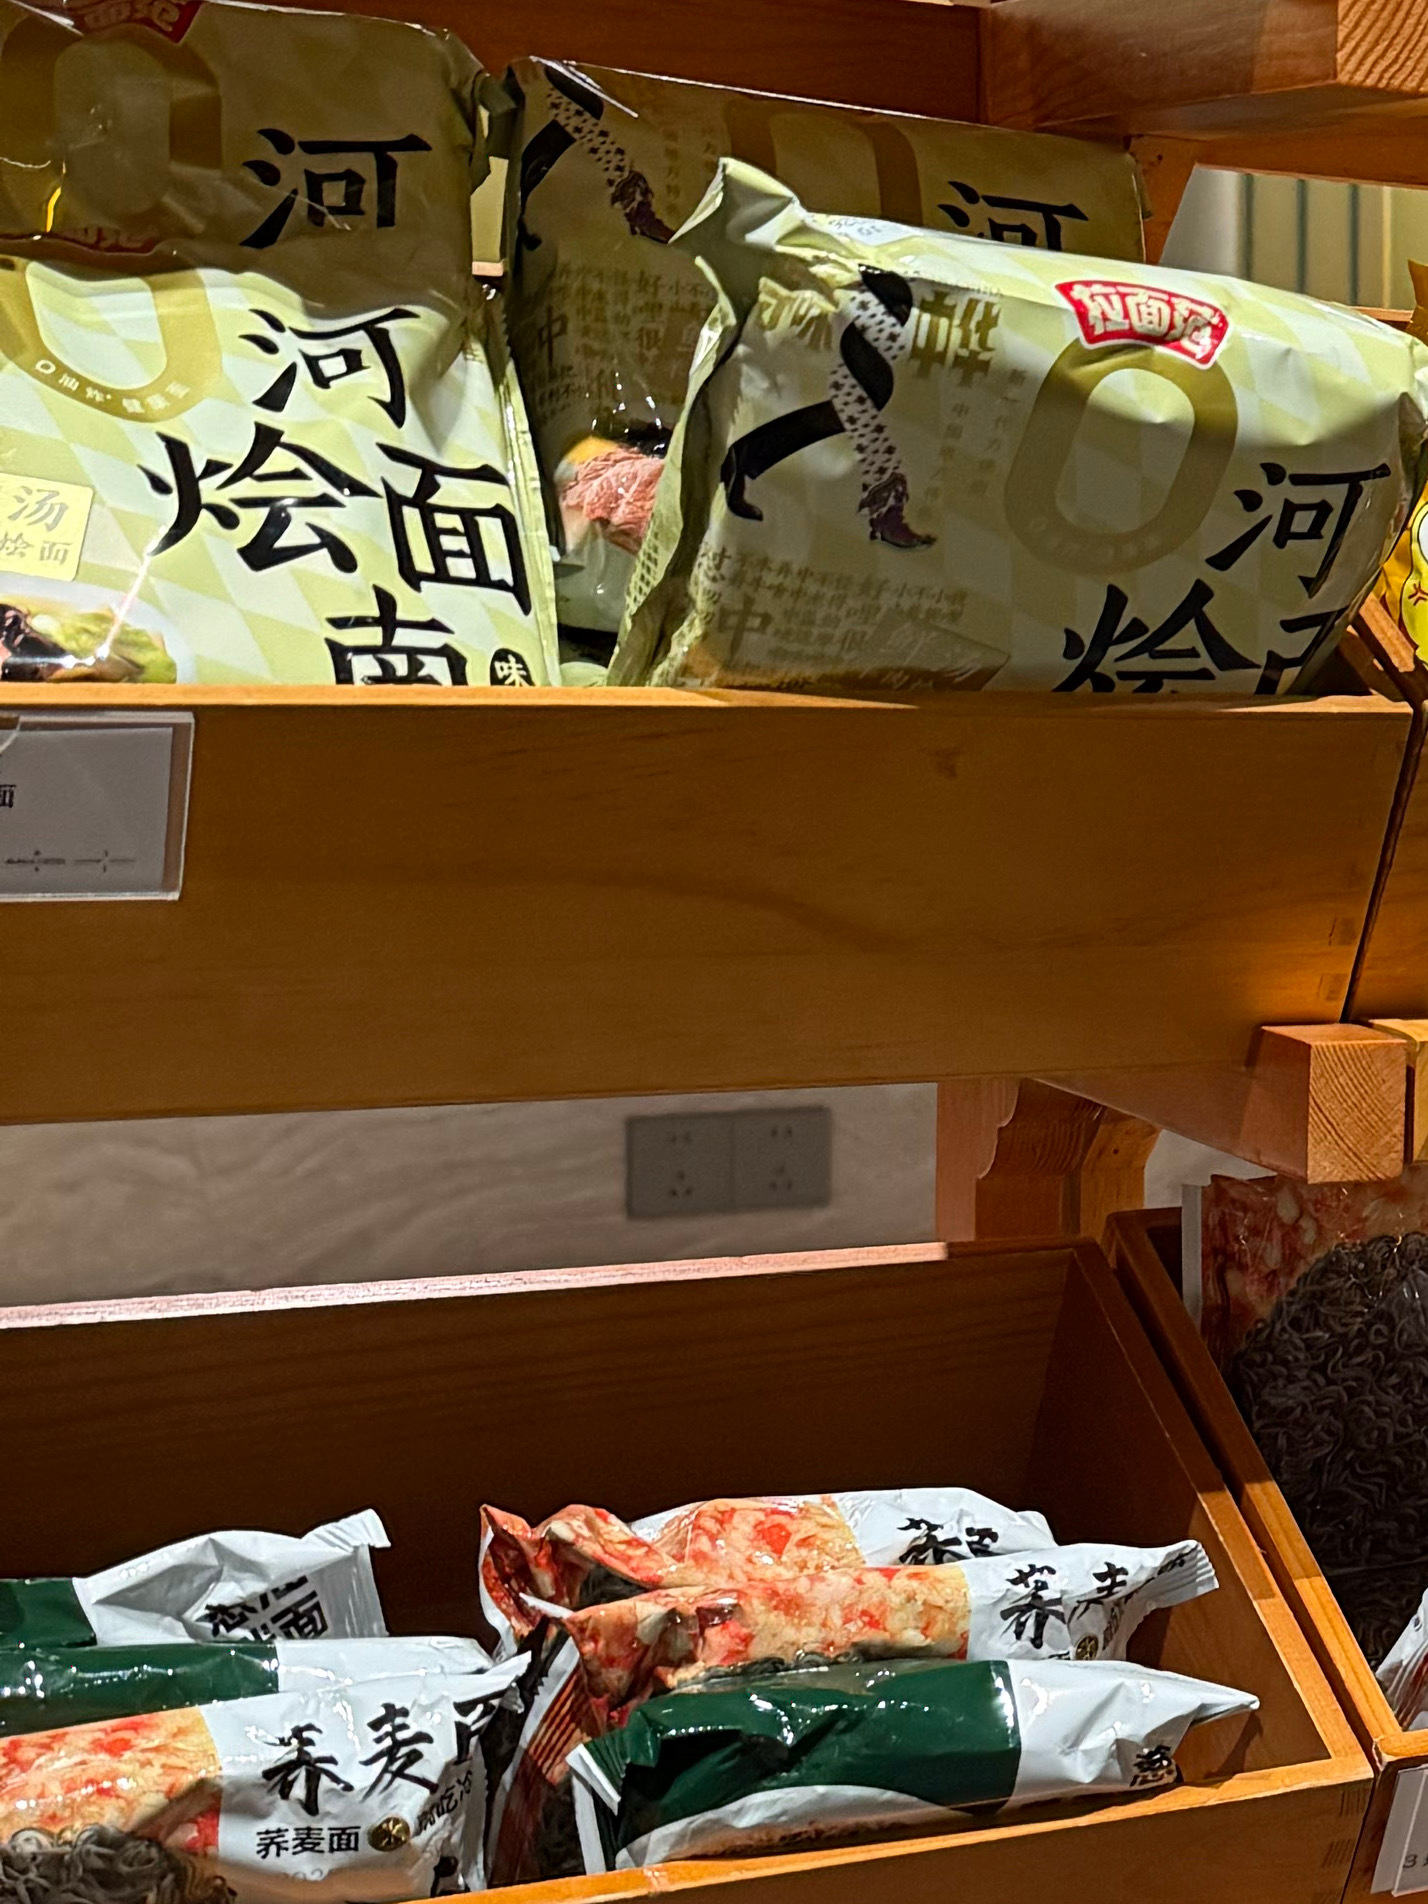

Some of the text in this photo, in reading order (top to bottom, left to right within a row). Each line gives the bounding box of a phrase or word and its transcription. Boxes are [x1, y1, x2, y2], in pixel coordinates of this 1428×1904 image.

[242, 127, 431, 248] 河
[239, 304, 422, 429] 河
[1070, 285, 1226, 359] 拉面范
[138, 423, 531, 616] 烩面
[1207, 463, 1391, 599] 河
[1055, 579, 1350, 694] 烩
[256, 1825, 361, 1859] 荞麦面
